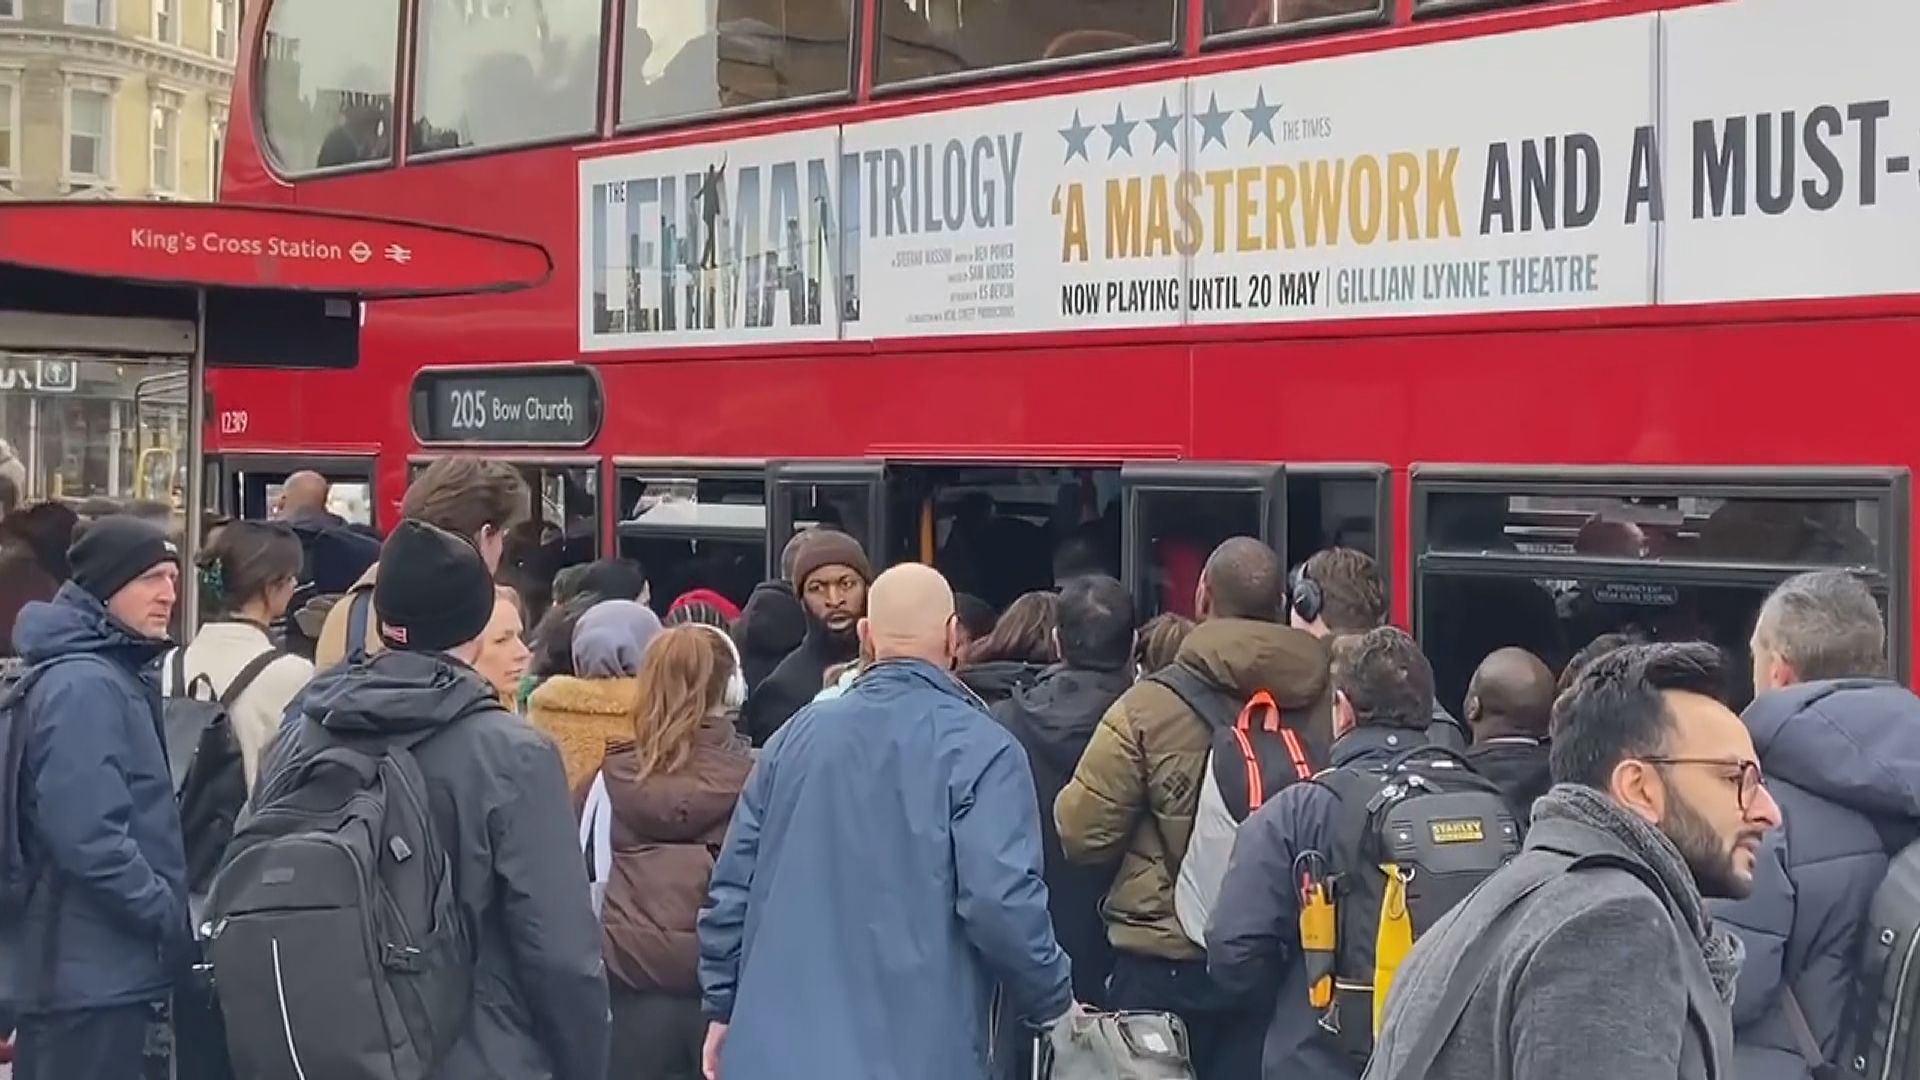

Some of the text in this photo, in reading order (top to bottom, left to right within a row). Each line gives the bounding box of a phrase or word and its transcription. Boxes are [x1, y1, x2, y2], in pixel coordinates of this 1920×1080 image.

[1283, 117, 1332, 142] THE TIMES
[608, 181, 626, 204] THE
[863, 132, 1023, 238] TRILOGY
[1105, 147, 1462, 260] MASTERWORK
[1479, 132, 1601, 236] AND
[1624, 125, 1665, 225] A
[1692, 99, 1920, 219] MUST-
[130, 228, 343, 260] King's Cross Station
[592, 152, 861, 335] LEHMAN
[1061, 254, 1600, 316] NOW PLAYING UNTIL 20 MAY GILLIAN LYNNE THEATRE
[451, 390, 574, 429] 205 Bow Church
[1432, 821, 1481, 834] STANLEY
